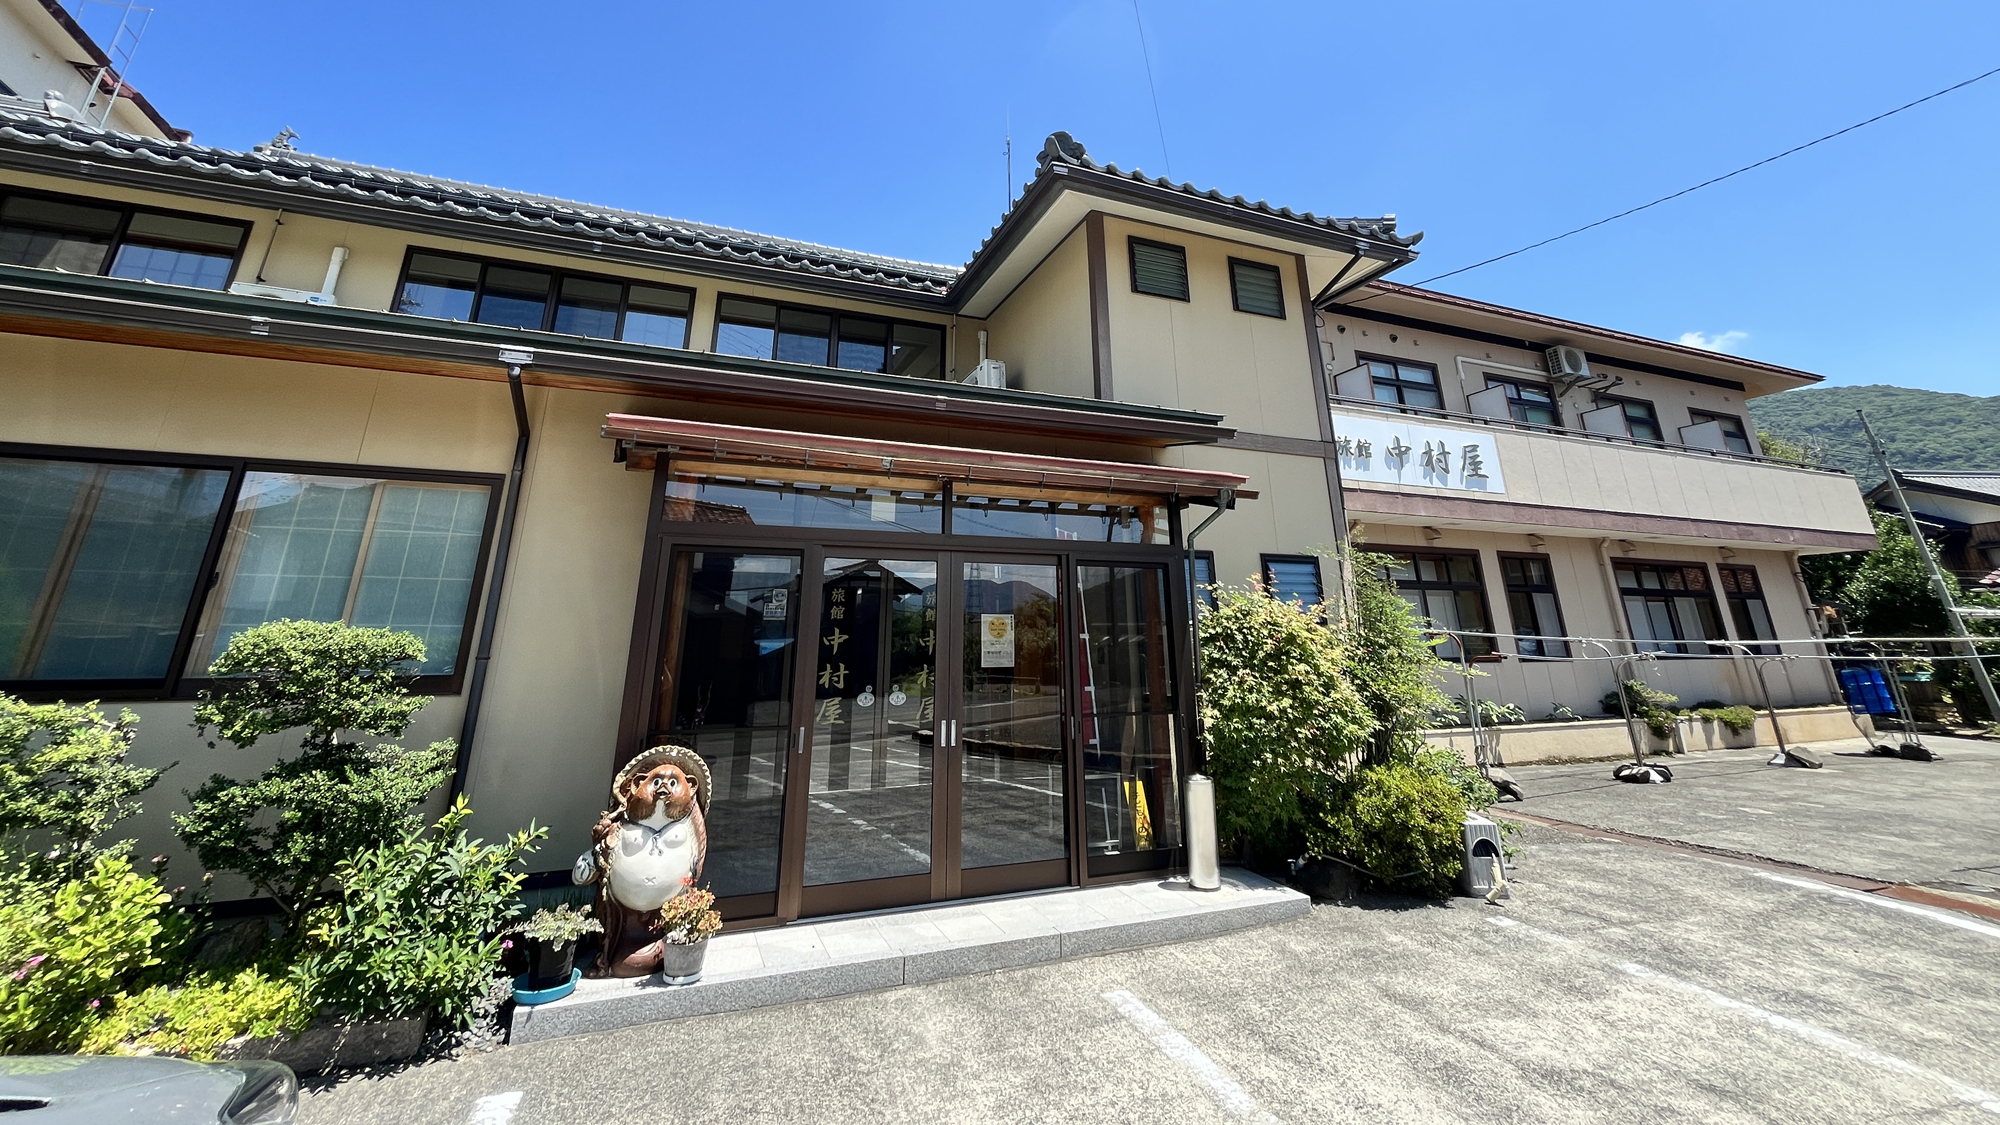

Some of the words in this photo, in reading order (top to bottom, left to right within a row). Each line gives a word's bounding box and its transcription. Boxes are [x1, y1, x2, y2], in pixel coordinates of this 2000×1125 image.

[1335, 435, 1373, 459] 旅館
[1386, 435, 1490, 479] 中村屋
[830, 587, 846, 620] 旅館
[815, 626, 850, 725] 中村屋
